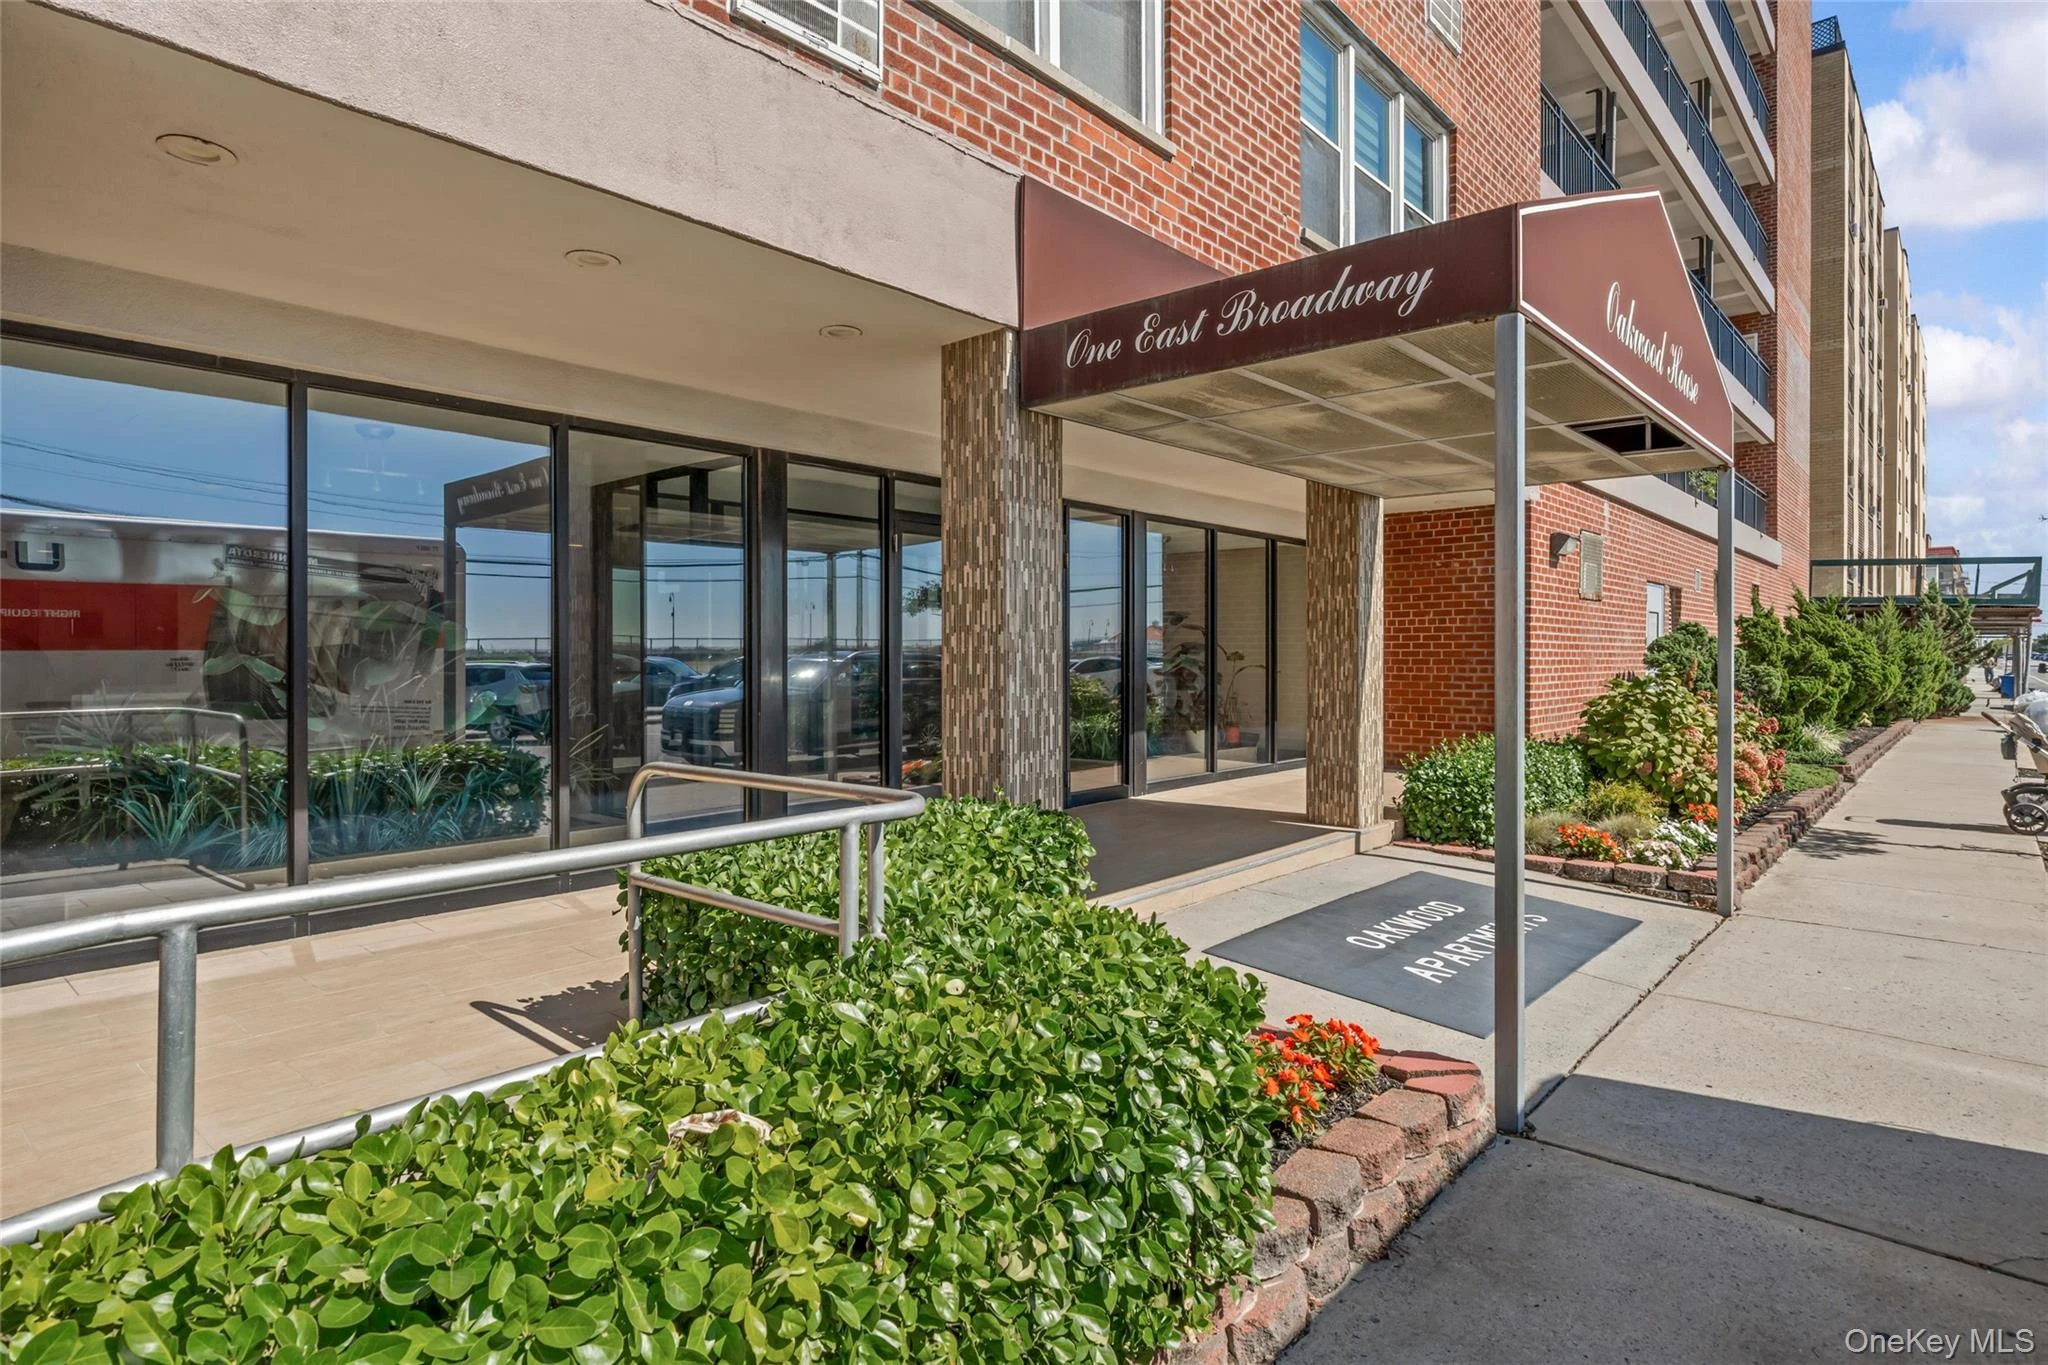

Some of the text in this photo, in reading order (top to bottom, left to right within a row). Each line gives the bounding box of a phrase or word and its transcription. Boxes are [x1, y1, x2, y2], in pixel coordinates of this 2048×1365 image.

[1065, 265, 1435, 369] One East Broadway
[1606, 281, 1699, 404] Oakwood House
[1345, 901, 1466, 950] OAKWOOD
[1403, 914, 1548, 984] APARTMS
